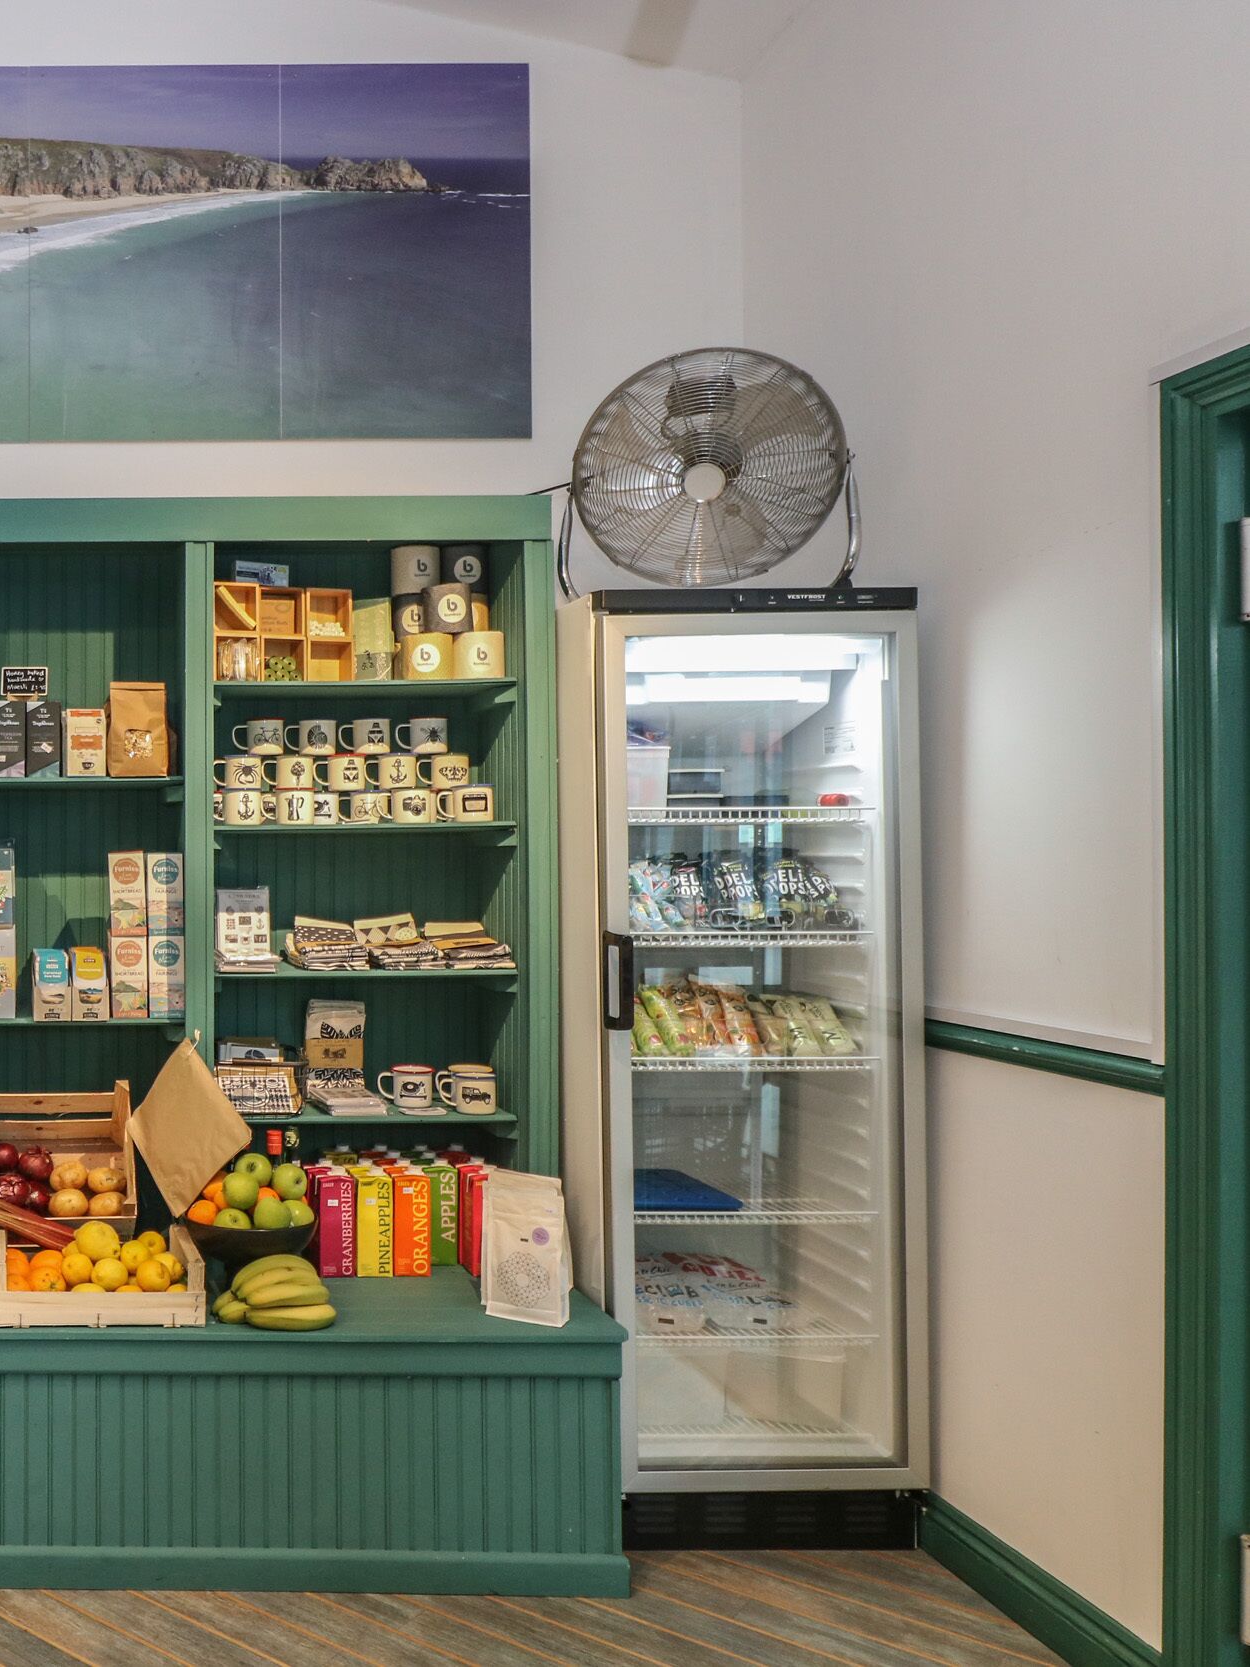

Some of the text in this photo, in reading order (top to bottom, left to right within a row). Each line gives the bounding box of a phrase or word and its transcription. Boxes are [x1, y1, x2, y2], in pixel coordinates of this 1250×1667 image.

[153, 865, 179, 873] Furniss
[340, 1182, 353, 1276] CRANBERRIES
[377, 1181, 390, 1274] PINEAPPLES
[412, 1181, 428, 1274] ORANGES
[440, 1172, 456, 1243] APPLES
